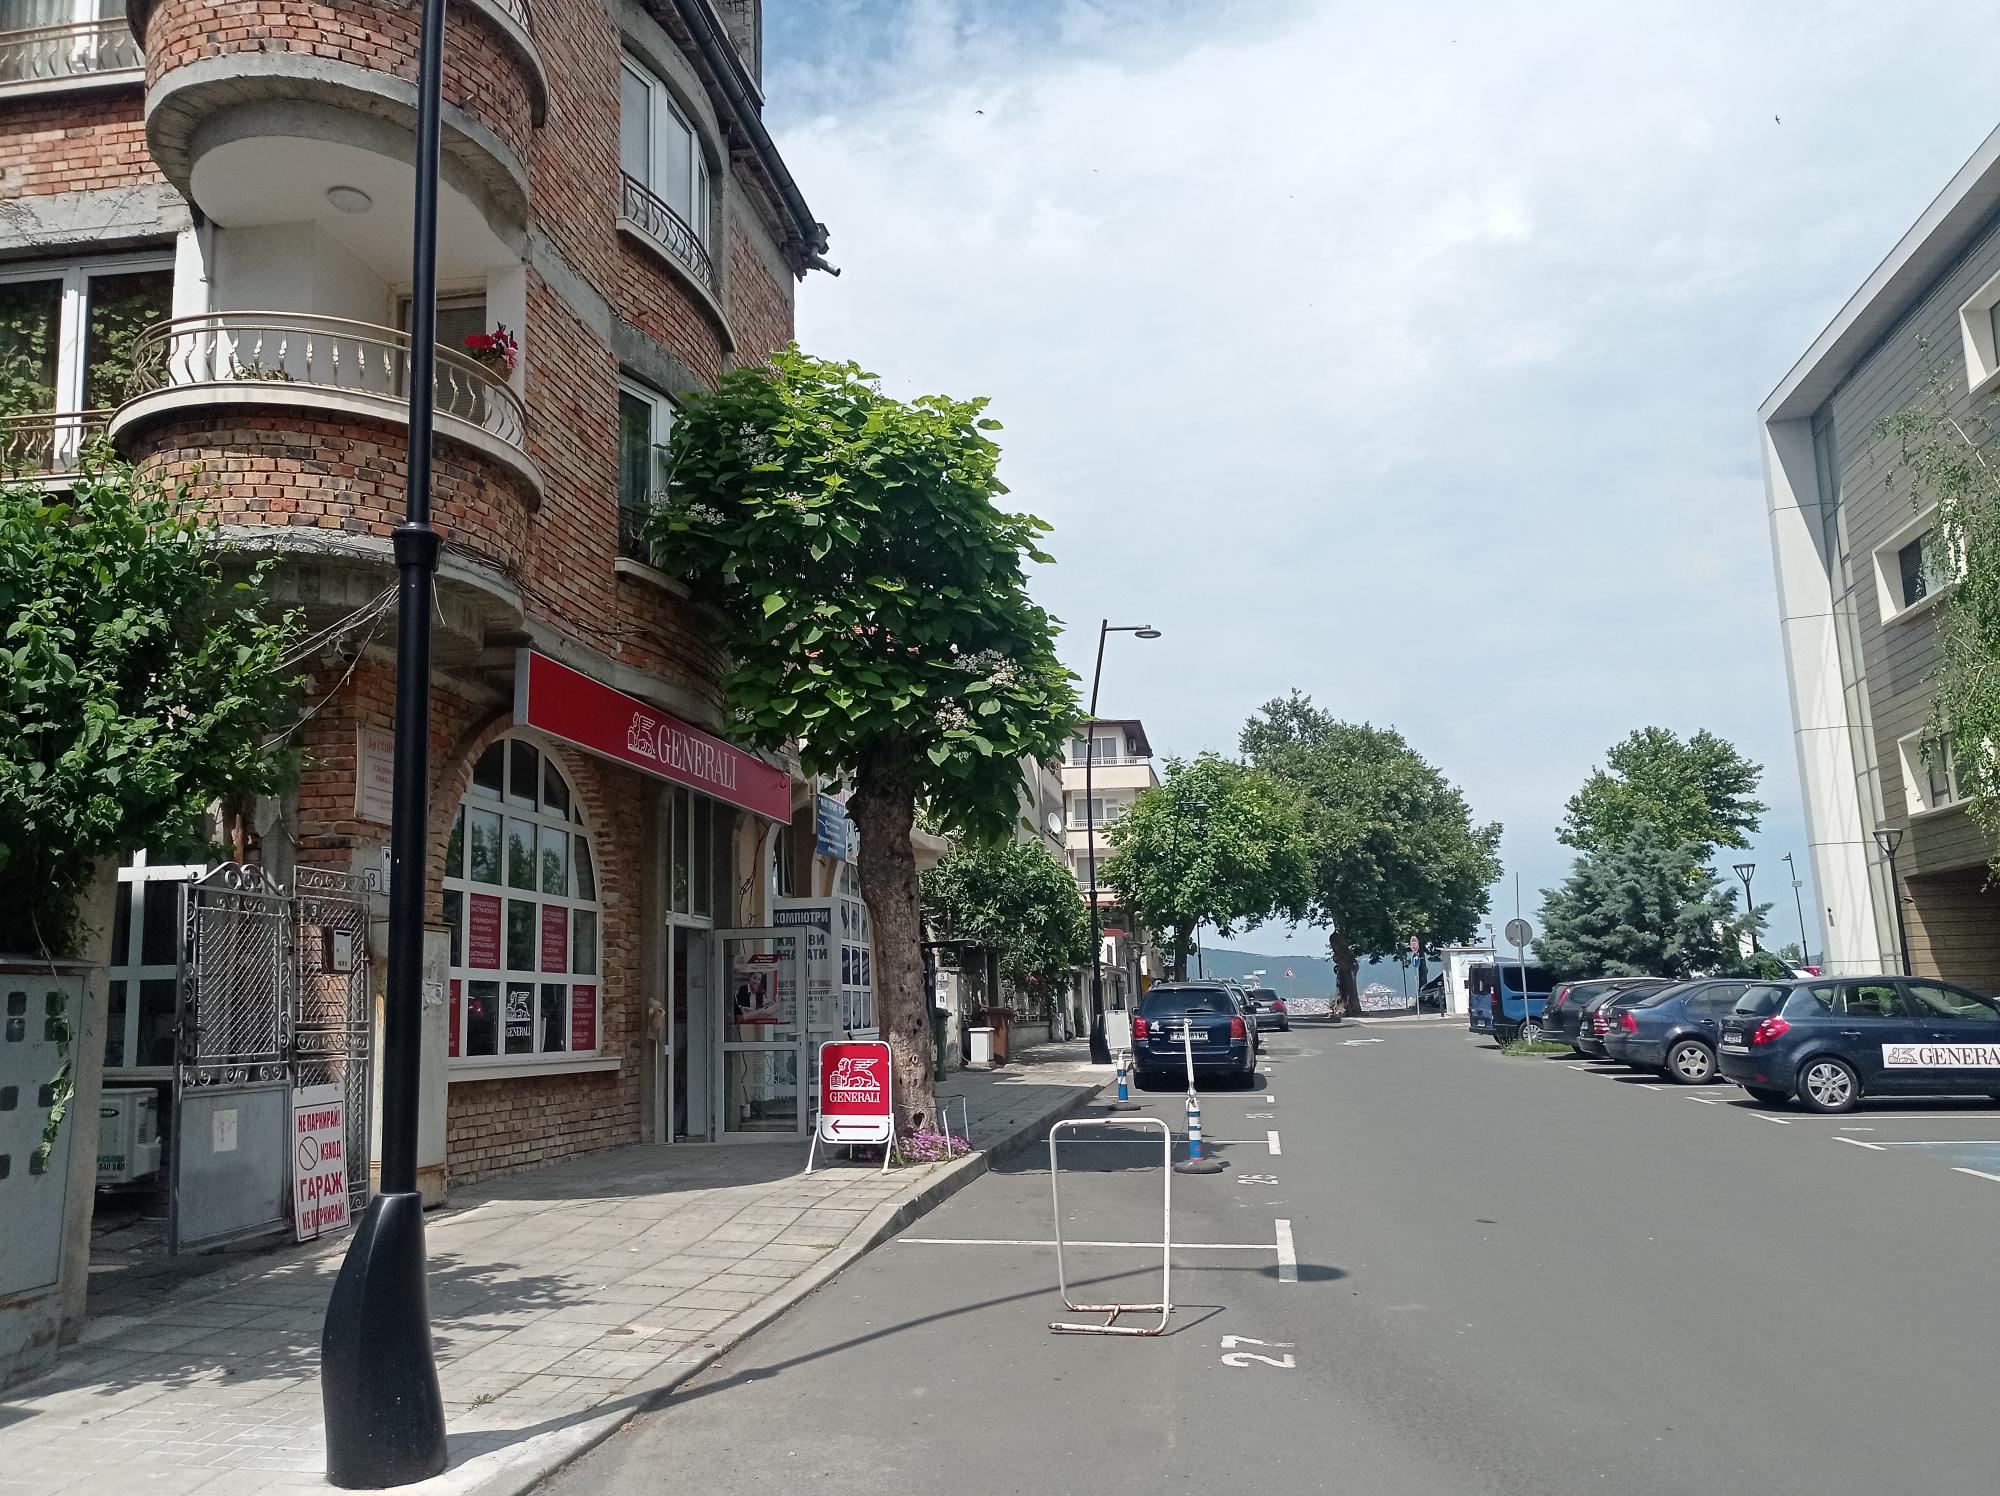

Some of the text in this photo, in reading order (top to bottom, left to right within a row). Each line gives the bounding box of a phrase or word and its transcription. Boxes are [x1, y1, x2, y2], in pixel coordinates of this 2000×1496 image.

[658, 725, 737, 790] GENERALI
[369, 872, 376, 887] 3
[311, 905, 318, 917] 3
[775, 911, 828, 924] КОМПЮТРИ
[506, 1026, 531, 1038] GENERALI
[1920, 1047, 2000, 1066] GENERA
[829, 1091, 881, 1103] GENERALI
[298, 1106, 341, 1133] НЕ ПАРКИРАЙ!
[320, 1140, 342, 1161] ИЗХОД
[300, 1170, 344, 1202] ГАРАЖ
[302, 1200, 346, 1231] НЕ ПАРКИРАЙ!
[1221, 1335, 1296, 1369] 27
